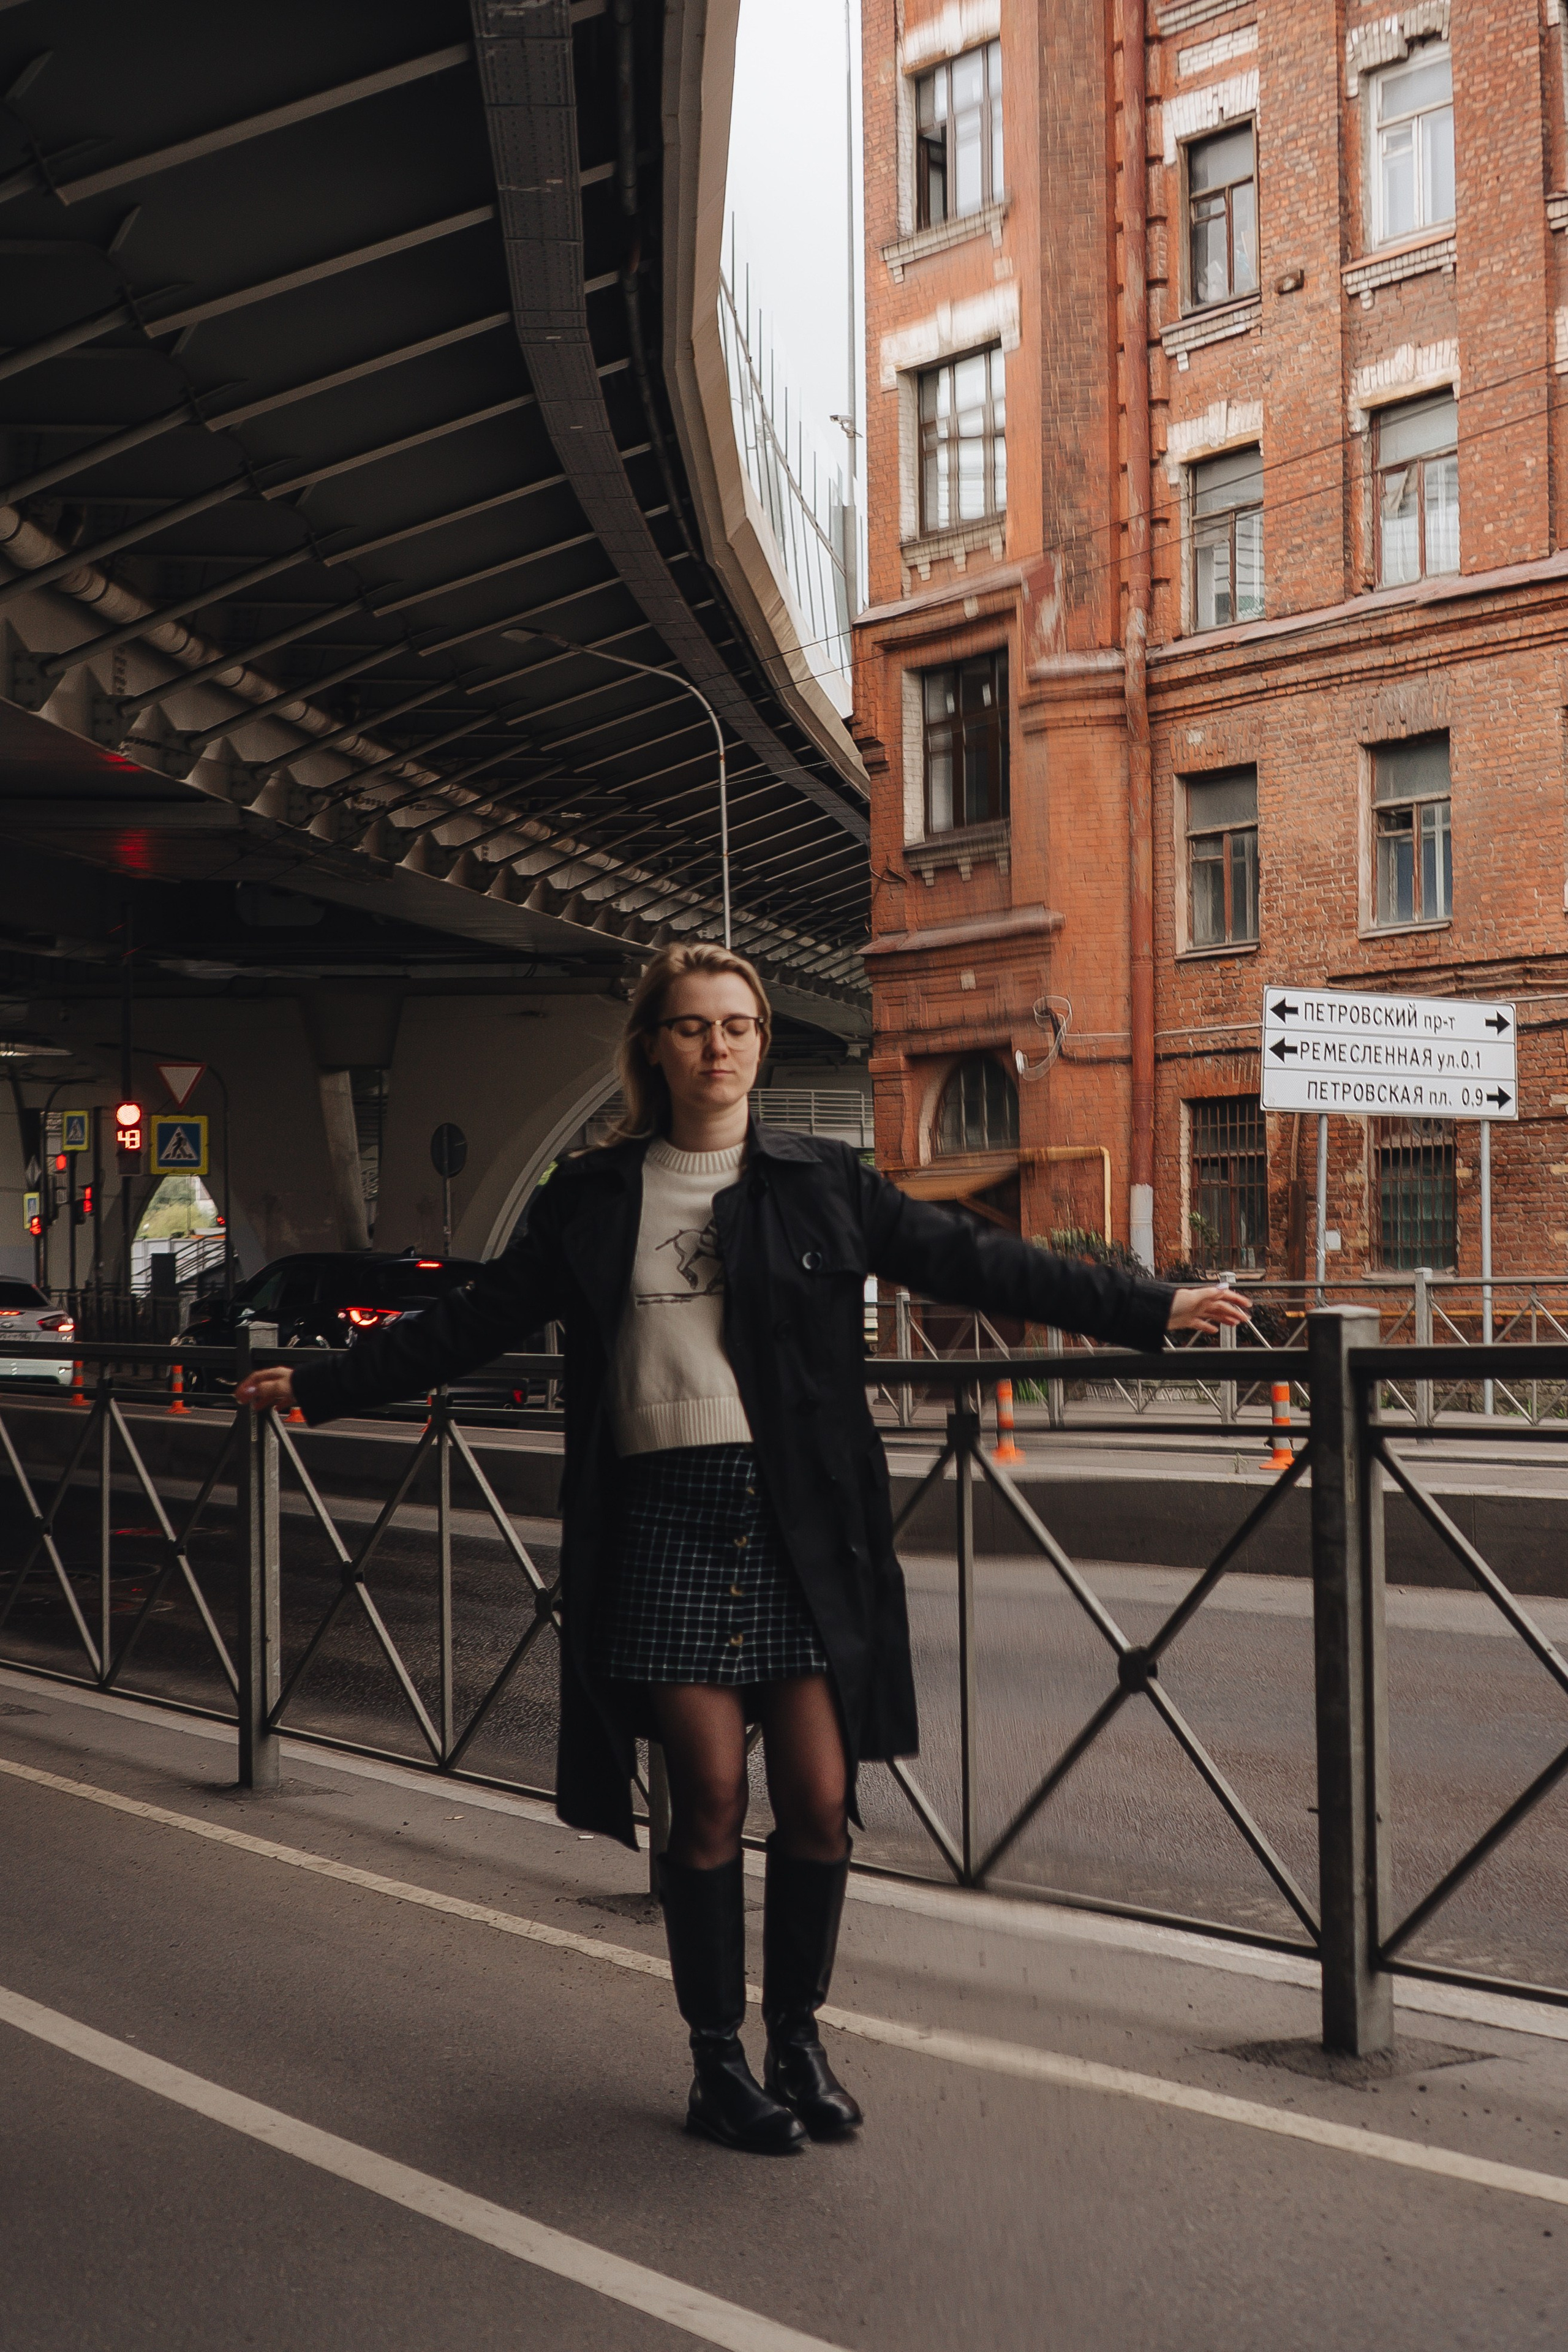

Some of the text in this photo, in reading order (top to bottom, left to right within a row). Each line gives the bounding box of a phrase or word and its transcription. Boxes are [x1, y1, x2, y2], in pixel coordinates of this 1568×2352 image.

[1304, 1001, 1455, 1035] ПЕТРОВСКИЙ пр-т
[1300, 1041, 1432, 1068] РЕМЕСЛЕННАЯ
[1307, 1080, 1423, 1105] ПЕТРОВСКАЯ
[1429, 1090, 1452, 1106] пл.
